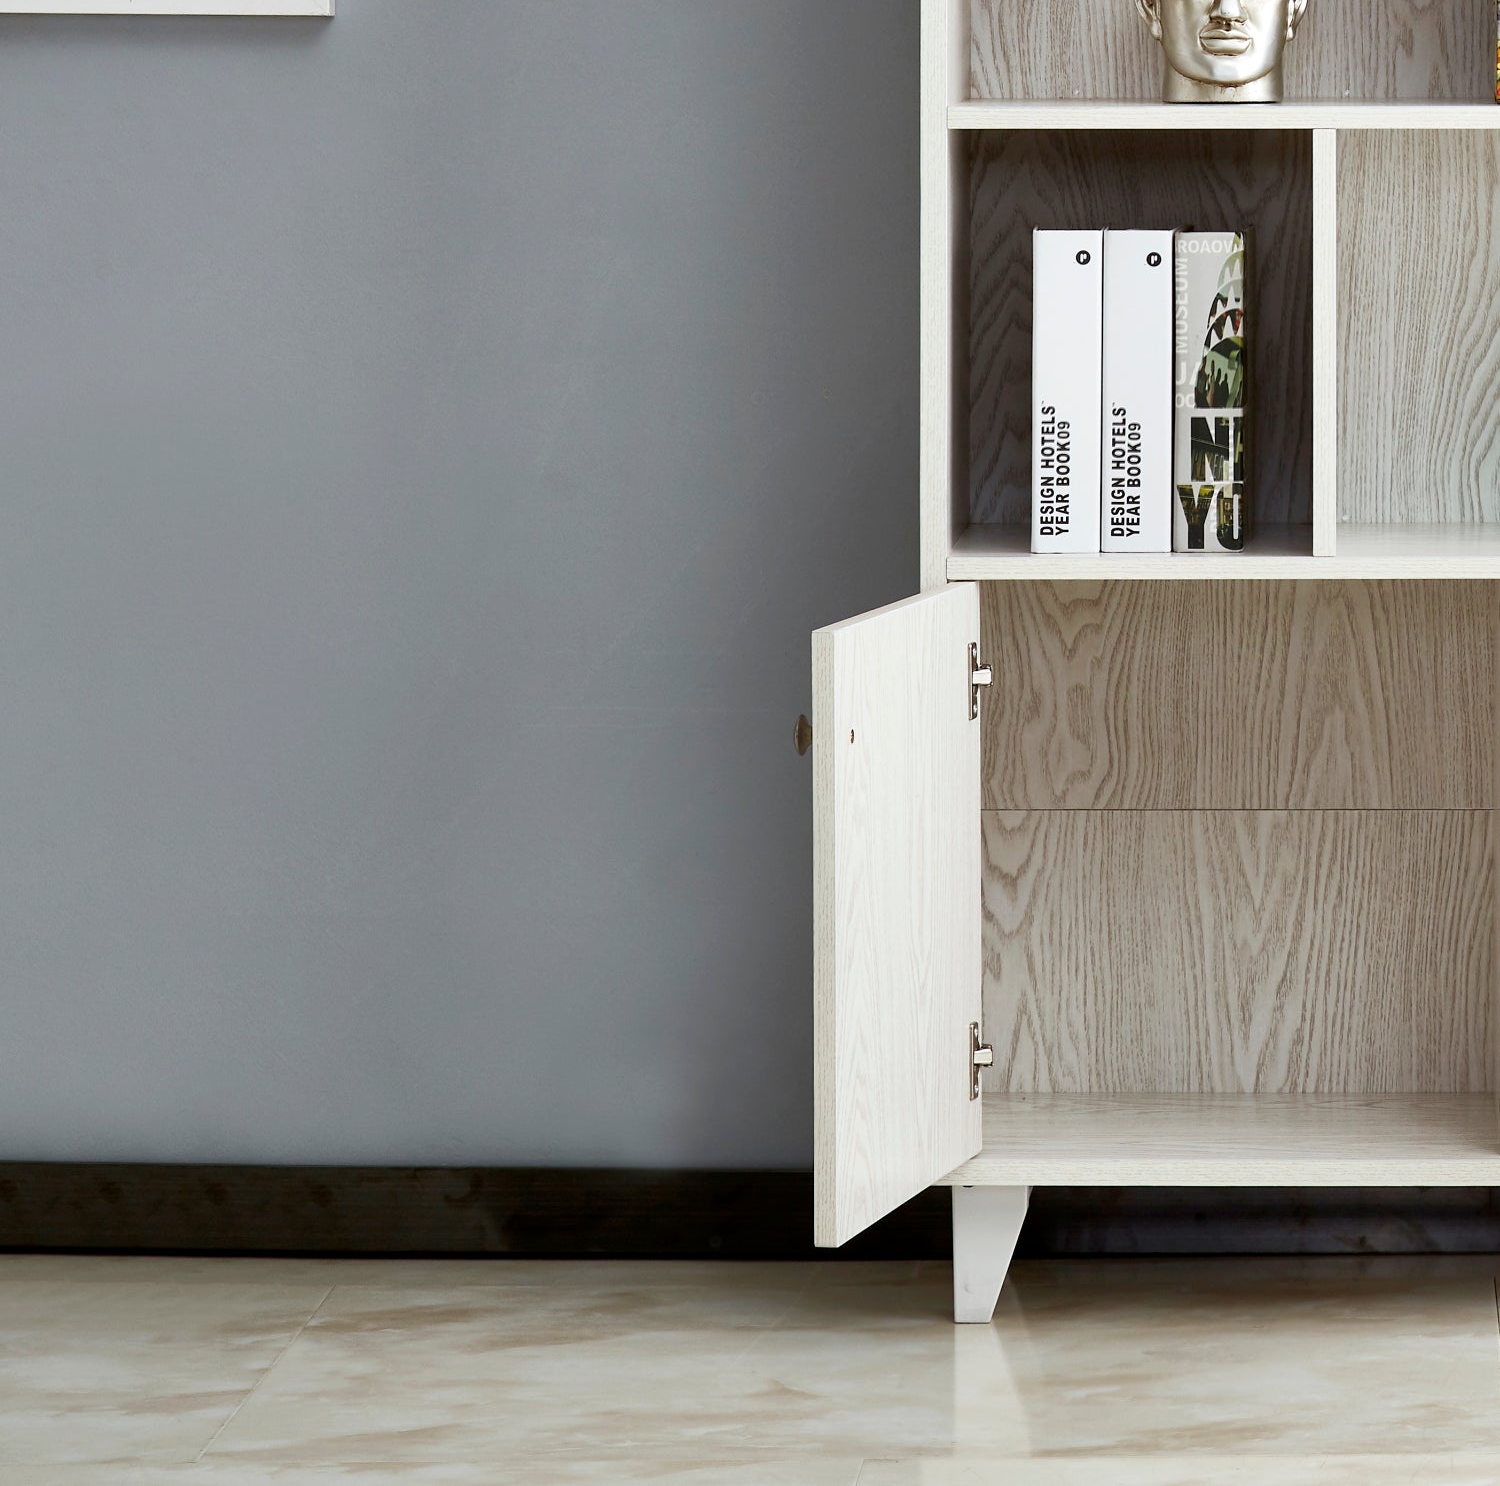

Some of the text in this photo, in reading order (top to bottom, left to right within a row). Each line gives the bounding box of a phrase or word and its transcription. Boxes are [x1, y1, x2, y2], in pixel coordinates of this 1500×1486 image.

[1040, 406, 1056, 535] DESIGN HOTELS
[1111, 407, 1127, 537] DESIGN HOTELS
[1056, 494, 1070, 536] YEAR
[1126, 495, 1140, 537] YEAR
